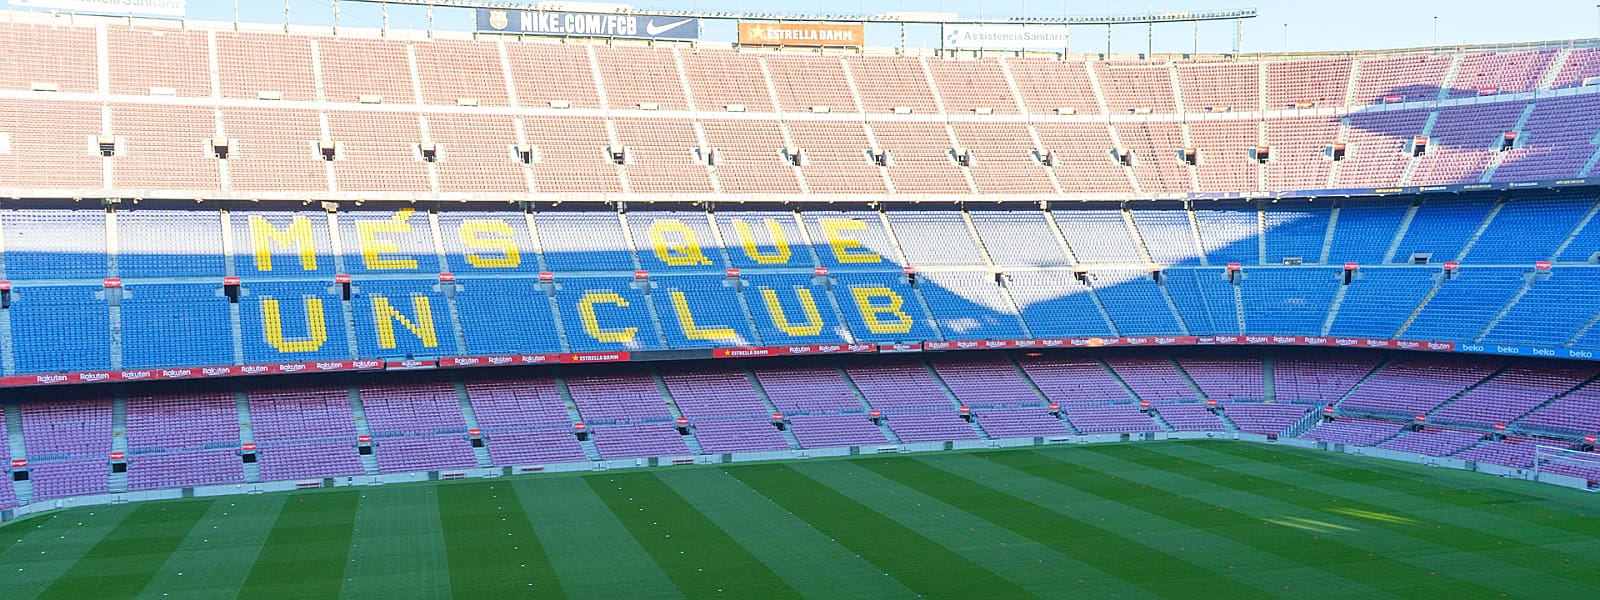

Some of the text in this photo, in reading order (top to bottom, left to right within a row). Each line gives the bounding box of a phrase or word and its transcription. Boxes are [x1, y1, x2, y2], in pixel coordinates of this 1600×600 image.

[520, 11, 637, 35] NIKE.COM/FCB
[767, 27, 852, 41] ESTRELLA DAMM
[249, 208, 881, 271] MÉS QUE
[261, 285, 913, 353] UN CLUB
[1463, 344, 1484, 352] beko
[1497, 345, 1519, 354] beko
[1533, 347, 1555, 356] beko
[1569, 349, 1592, 359] beko
[37, 375, 67, 383] Rakuten
[80, 373, 109, 381] Rakuten
[122, 371, 150, 379] Rakuten
